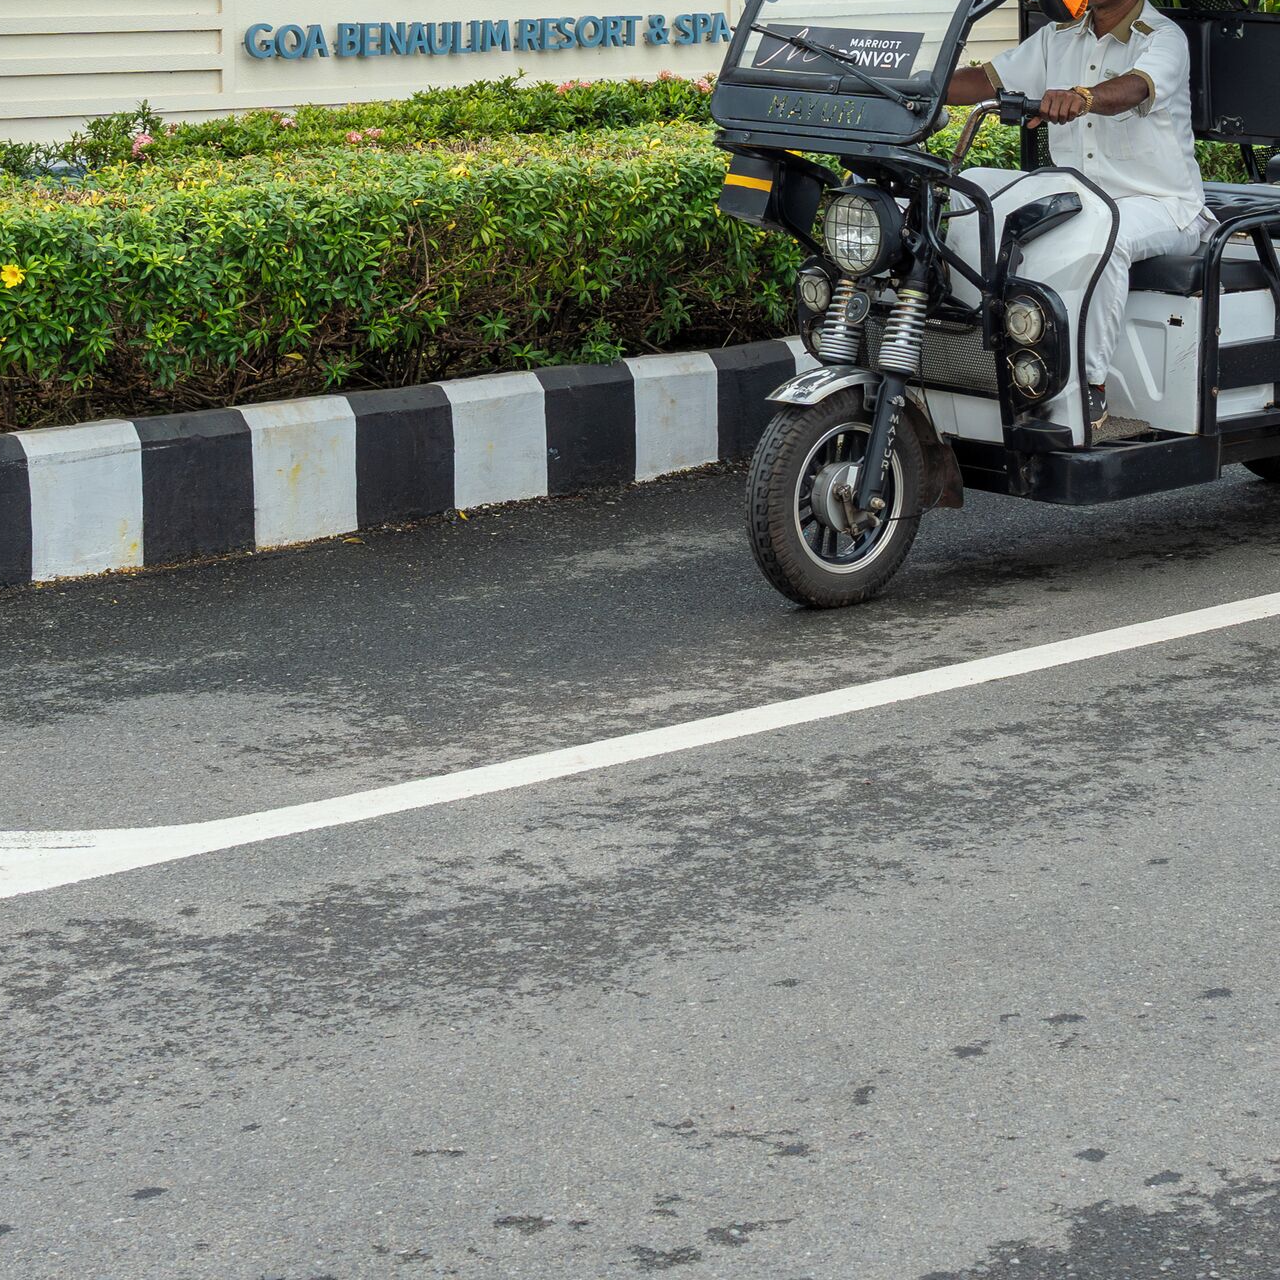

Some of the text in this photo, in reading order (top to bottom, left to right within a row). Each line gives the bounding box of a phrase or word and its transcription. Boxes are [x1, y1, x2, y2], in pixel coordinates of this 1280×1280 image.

[244, 12, 730, 60] GOA BENAULIM RESORT & SPA
[849, 38, 902, 50] MARRIOTT
[767, 95, 867, 125] MAYURI
[881, 413, 900, 481] MAYURI
